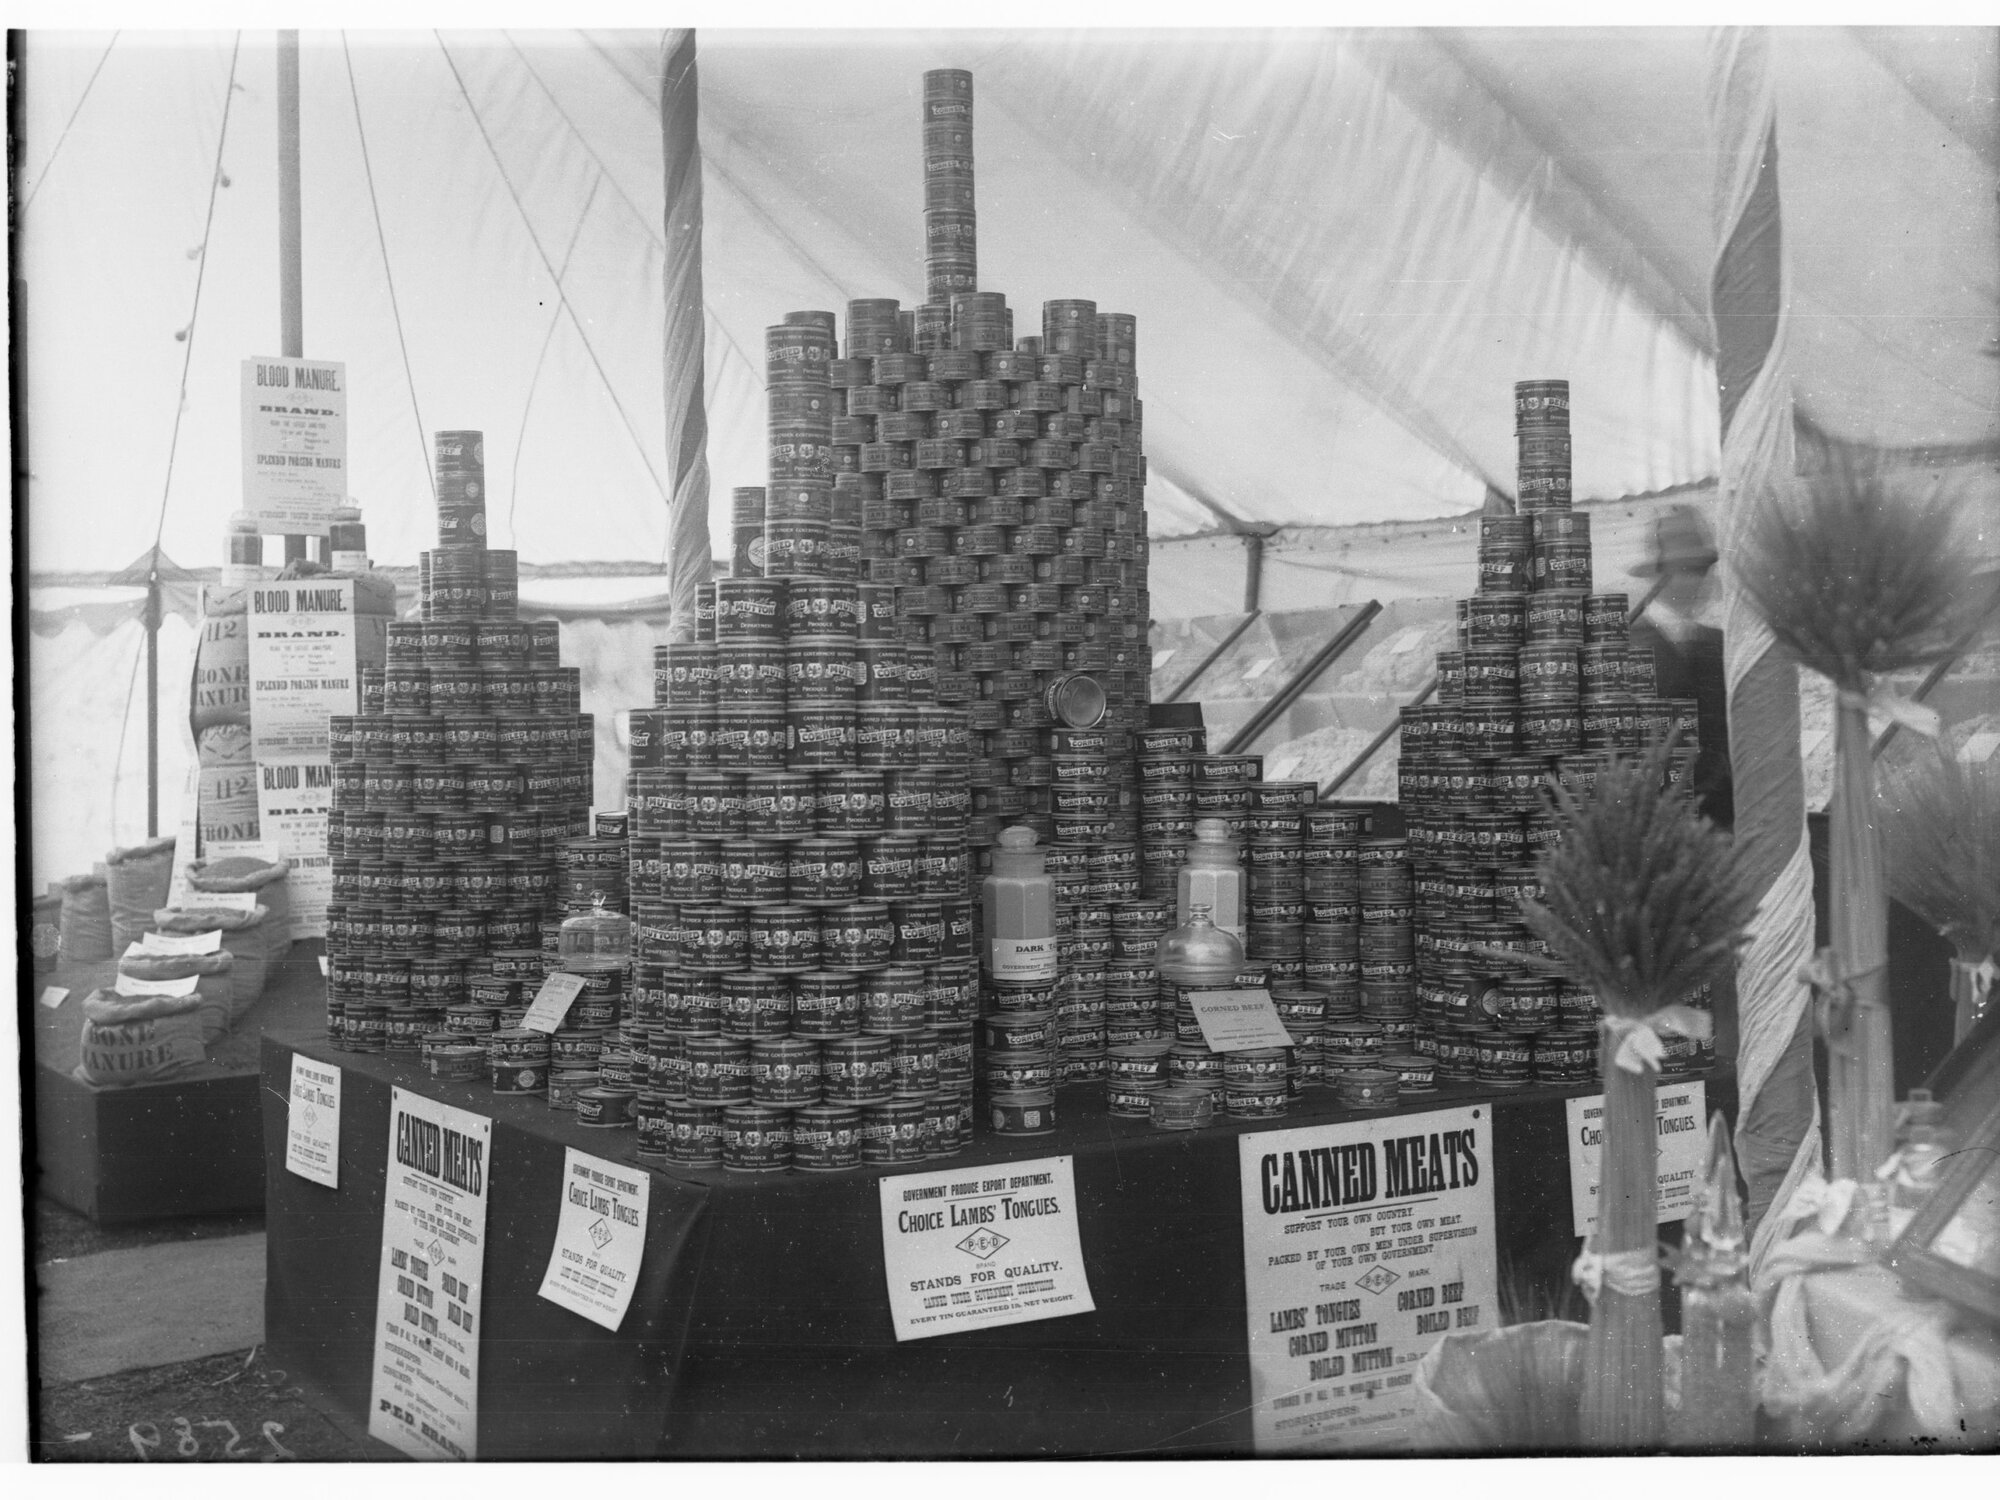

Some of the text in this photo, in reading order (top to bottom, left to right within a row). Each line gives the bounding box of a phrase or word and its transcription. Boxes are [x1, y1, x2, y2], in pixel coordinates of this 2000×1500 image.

[257, 364, 341, 391] BLOOD MANURE.
[259, 405, 340, 417] BRAND.
[255, 589, 347, 613] BLOOD MANURE.
[734, 601, 775, 615] MUTTON
[207, 620, 238, 642] 112
[258, 631, 346, 639] BRAND.
[256, 680, 287, 691] SPLENDID
[801, 728, 843, 742] CORNED
[859, 730, 899, 743] CORNED
[1147, 738, 1178, 748] CORNED
[264, 766, 299, 790] BLOOD
[1059, 767, 1091, 777] CORNED
[1145, 767, 1176, 776] CORNED
[1207, 766, 1238, 776] CORNED
[216, 776, 249, 800] 112
[892, 794, 931, 808] CORNED
[1059, 798, 1090, 807] CORNED
[268, 807, 328, 815] BRAN
[1057, 826, 1088, 835] CORNED
[1314, 823, 1345, 833] CORNED
[870, 860, 911, 874] CORNED
[1317, 907, 1346, 916] CORNED
[1015, 944, 1044, 953] DARK
[1126, 942, 1157, 951] CORNED
[1000, 995, 1031, 1004] CORNED
[1201, 1003, 1265, 1013] CORNED BEEF
[1297, 1005, 1322, 1014] BEEF
[1010, 1032, 1042, 1043] CORNED
[1107, 1031, 1139, 1041] CORNED
[1127, 1063, 1154, 1073] BEEF
[1407, 1072, 1431, 1081] BEEF
[1227, 1097, 1257, 1107] CORNED
[1661, 1095, 1692, 1110] DEPARTMENT.
[1583, 1107, 1603, 1120] GOVERN
[1656, 1115, 1697, 1136] TONGUES.
[1581, 1126, 1602, 1146] CHO
[396, 1110, 483, 1198] CANNED MEATS
[1261, 1128, 1479, 1215] CANNED MEATS
[1657, 1169, 1696, 1184] QUALITY.
[903, 1172, 1054, 1202] GOVERNMENT PRODUCE EXPORT DEPARTMENT.
[568, 1181, 588, 1209] CHOICE
[899, 1197, 1061, 1233] CHOICE LAMBS' TONGUES.
[1284, 1207, 1415, 1234] SUPPORT YOUR OWN COUNTRY.
[1370, 1215, 1462, 1237] BUY YOUR OWN MEAT.
[1268, 1226, 1478, 1266] PACKED BY YOUR OWN MEN UNDER SUPERVISION
[1315, 1244, 1434, 1271] OF YOUR OWN GOVERNMENT
[561, 1248, 583, 1266] STANDS
[585, 1257, 598, 1271] FOR
[599, 1264, 626, 1283] QUALITY.
[976, 1261, 996, 1269] BRAND
[910, 1260, 1063, 1292] STANDS FOR QUALITY.
[1319, 1281, 1346, 1292] TRADE
[1397, 1281, 1465, 1312] CORNED BEEF
[910, 1316, 937, 1325] EVERY
[939, 1313, 954, 1321] TIN
[955, 1304, 1010, 1318] GUARANTEED
[1024, 1299, 1040, 1307] NET
[1270, 1299, 1361, 1333] LAMBS' TONGUES
[1416, 1305, 1480, 1335] BOILED BEEF
[1289, 1322, 1378, 1357] CORNED MUTTON
[1310, 1355, 1345, 1381] BOILED
[1352, 1346, 1393, 1373] MUTTON
